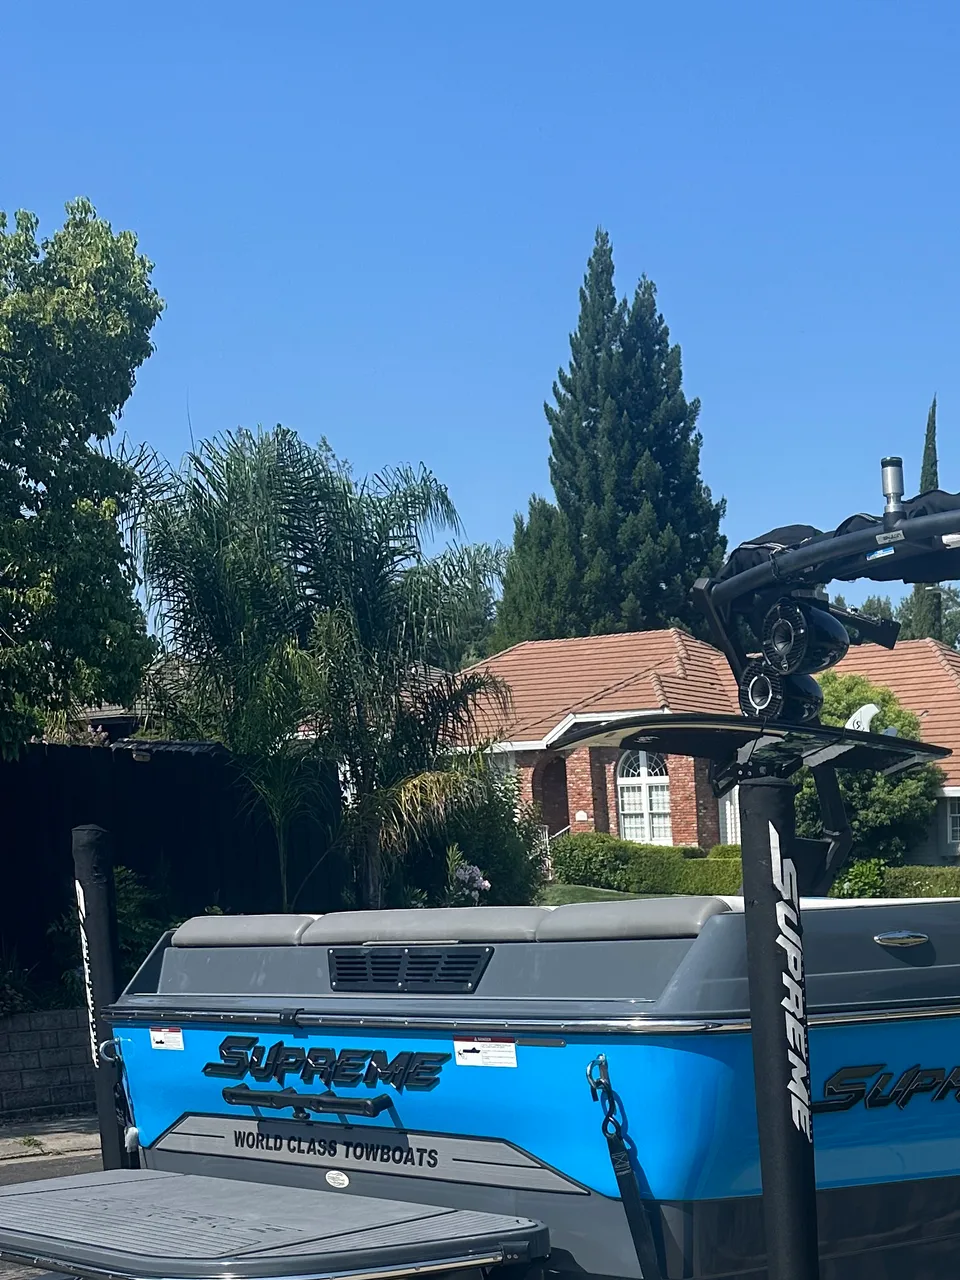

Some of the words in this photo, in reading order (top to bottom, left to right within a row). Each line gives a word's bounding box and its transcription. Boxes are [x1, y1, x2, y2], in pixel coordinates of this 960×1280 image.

[768, 820, 812, 1144] SUPREME
[204, 1036, 452, 1094] SUPREME
[234, 1130, 283, 1152] WORLD
[287, 1136, 337, 1158] CLASS
[344, 1141, 438, 1168] TOWBOATS
